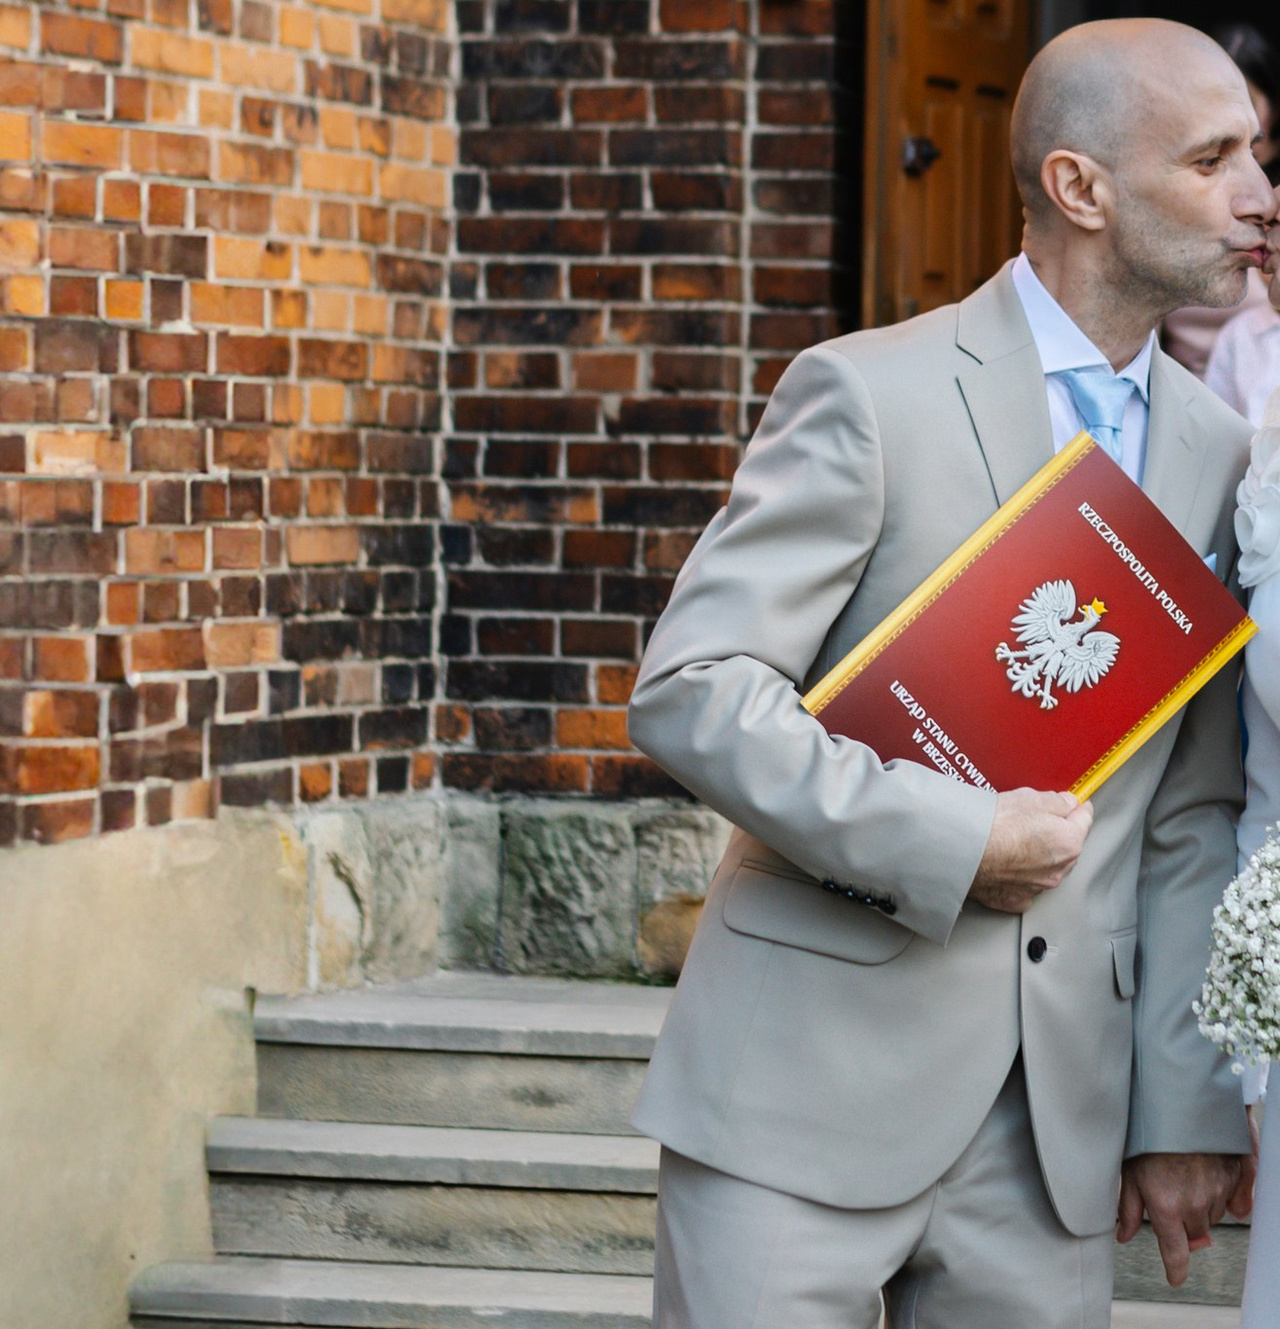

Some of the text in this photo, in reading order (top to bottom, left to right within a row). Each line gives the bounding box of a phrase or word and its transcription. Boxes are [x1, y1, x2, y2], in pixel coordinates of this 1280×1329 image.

[1078, 501, 1193, 635] RZECZPOSPOLITA POLSKA
[889, 679, 998, 793] URZĄD STANU CYWILN
[912, 727, 969, 784] W BRZESK
